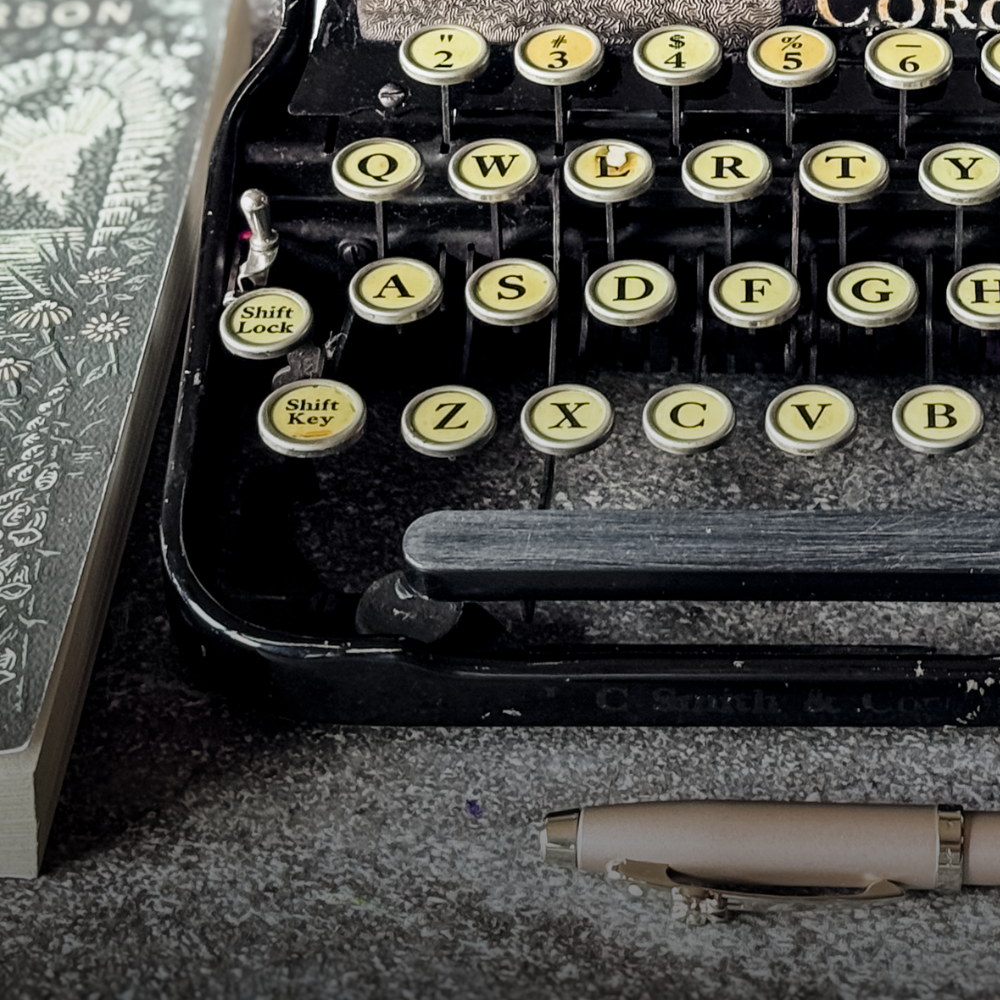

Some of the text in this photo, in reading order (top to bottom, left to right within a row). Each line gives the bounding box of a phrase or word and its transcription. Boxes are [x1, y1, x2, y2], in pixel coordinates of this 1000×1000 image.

[551, 34, 567, 49] #
[668, 34, 686, 50] $
[781, 34, 803, 51] %
[434, 50, 454, 69] 2
[547, 50, 569, 69] 3
[663, 51, 687, 69] 4
[782, 51, 803, 71] 5
[898, 54, 920, 73] 6
[358, 153, 401, 183] Q
[473, 154, 520, 178] W
[710, 155, 750, 180] R
[824, 155, 867, 179] T
[943, 157, 984, 181] Y
[372, 273, 415, 299] A
[497, 274, 527, 301] S
[612, 275, 655, 302] D
[740, 278, 772, 304] F
[851, 277, 894, 304] G
[240, 305, 294, 320] Shift
[237, 321, 294, 335] Lock
[285, 398, 340, 411] Shift
[432, 402, 469, 431] Z
[548, 402, 590, 429] X
[669, 401, 707, 429] C
[924, 402, 958, 429] B
[287, 412, 334, 428] Key
[790, 403, 832, 431] V
